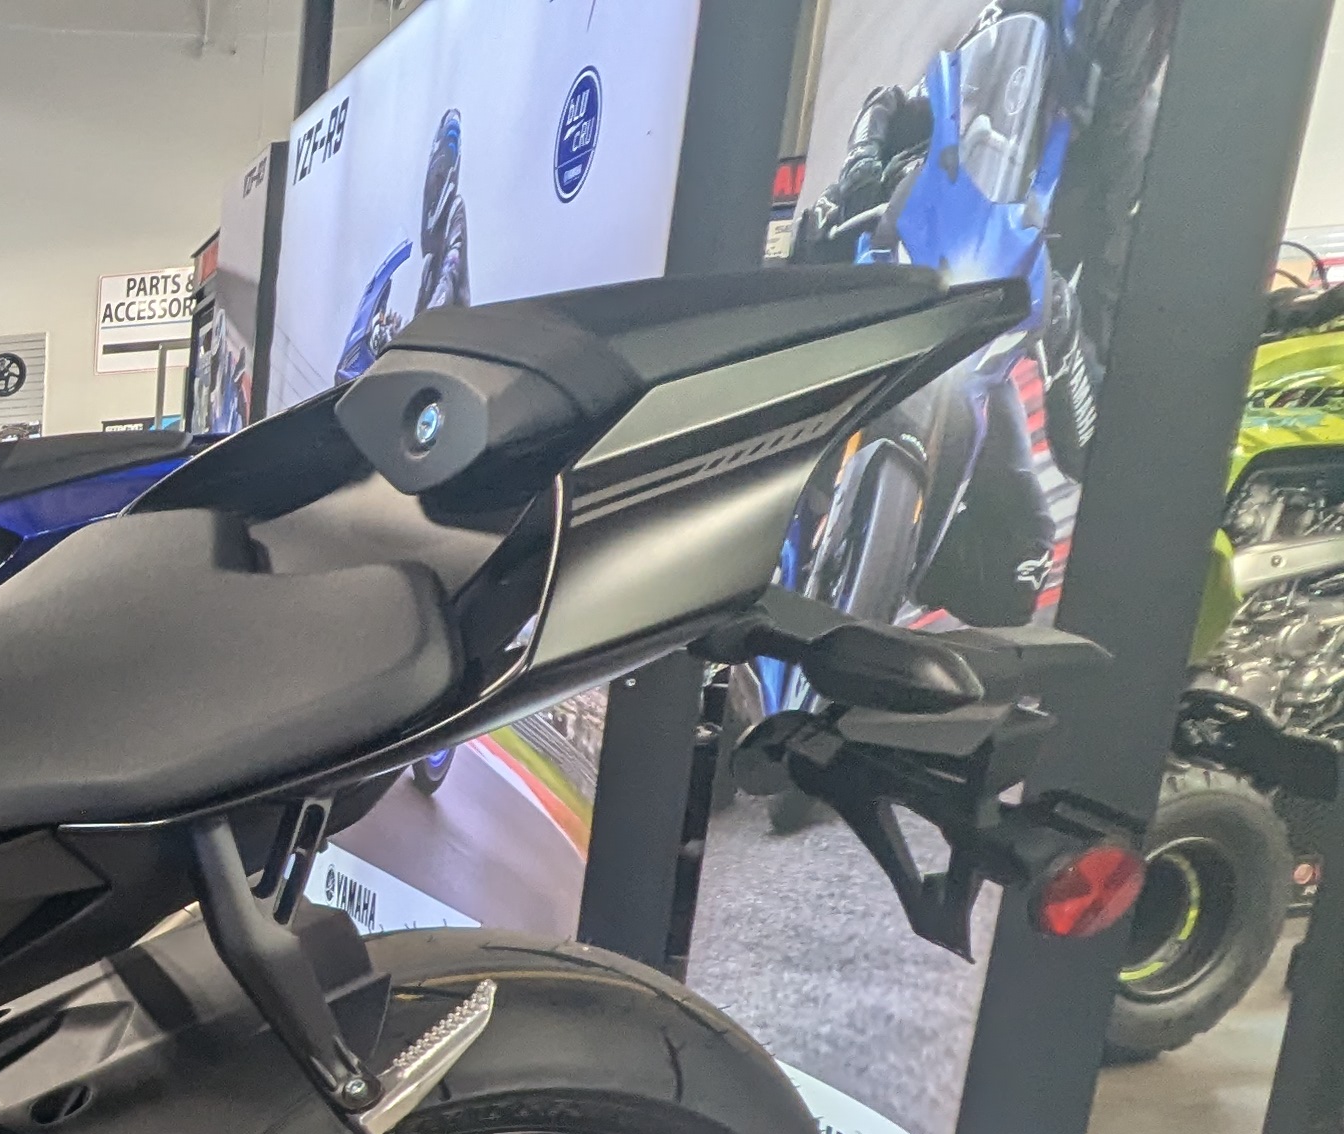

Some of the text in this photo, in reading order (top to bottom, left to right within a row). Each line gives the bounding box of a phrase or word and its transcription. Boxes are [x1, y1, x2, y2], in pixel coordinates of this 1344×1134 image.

[292, 95, 350, 186] YZF-R9
[125, 272, 182, 298] PARTS
[101, 296, 196, 324] ACCESSOR
[336, 870, 377, 931] YAMAHA
